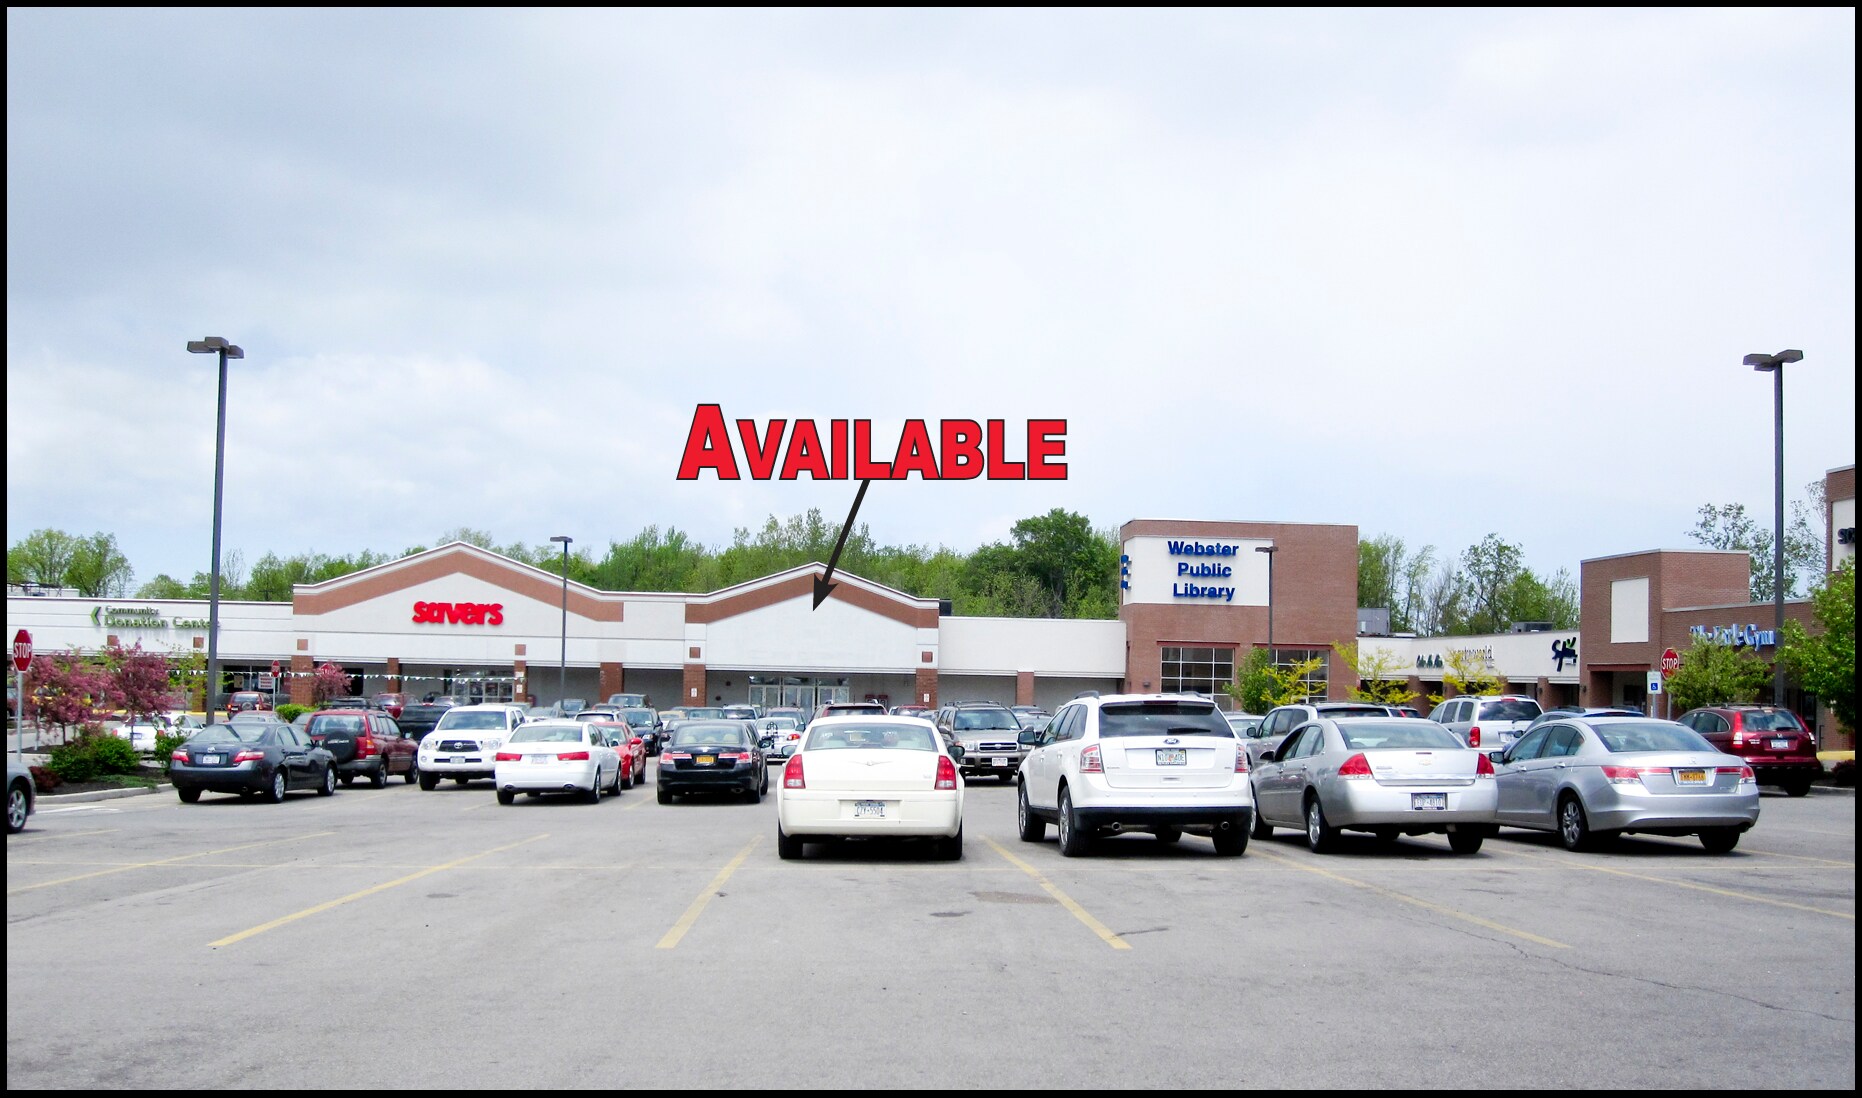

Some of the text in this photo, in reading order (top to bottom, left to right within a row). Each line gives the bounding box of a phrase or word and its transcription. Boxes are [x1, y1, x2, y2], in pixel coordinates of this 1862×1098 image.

[1167, 540, 1240, 557] Webster
[1177, 562, 1232, 578] Public
[1173, 583, 1236, 602] Library
[105, 605, 159, 615] Community
[412, 601, 504, 625] savers
[104, 615, 221, 629] Donation Cente
[1744, 624, 1776, 652] Gym
[14, 642, 32, 658] STOP
[1662, 658, 1678, 669] STOP
